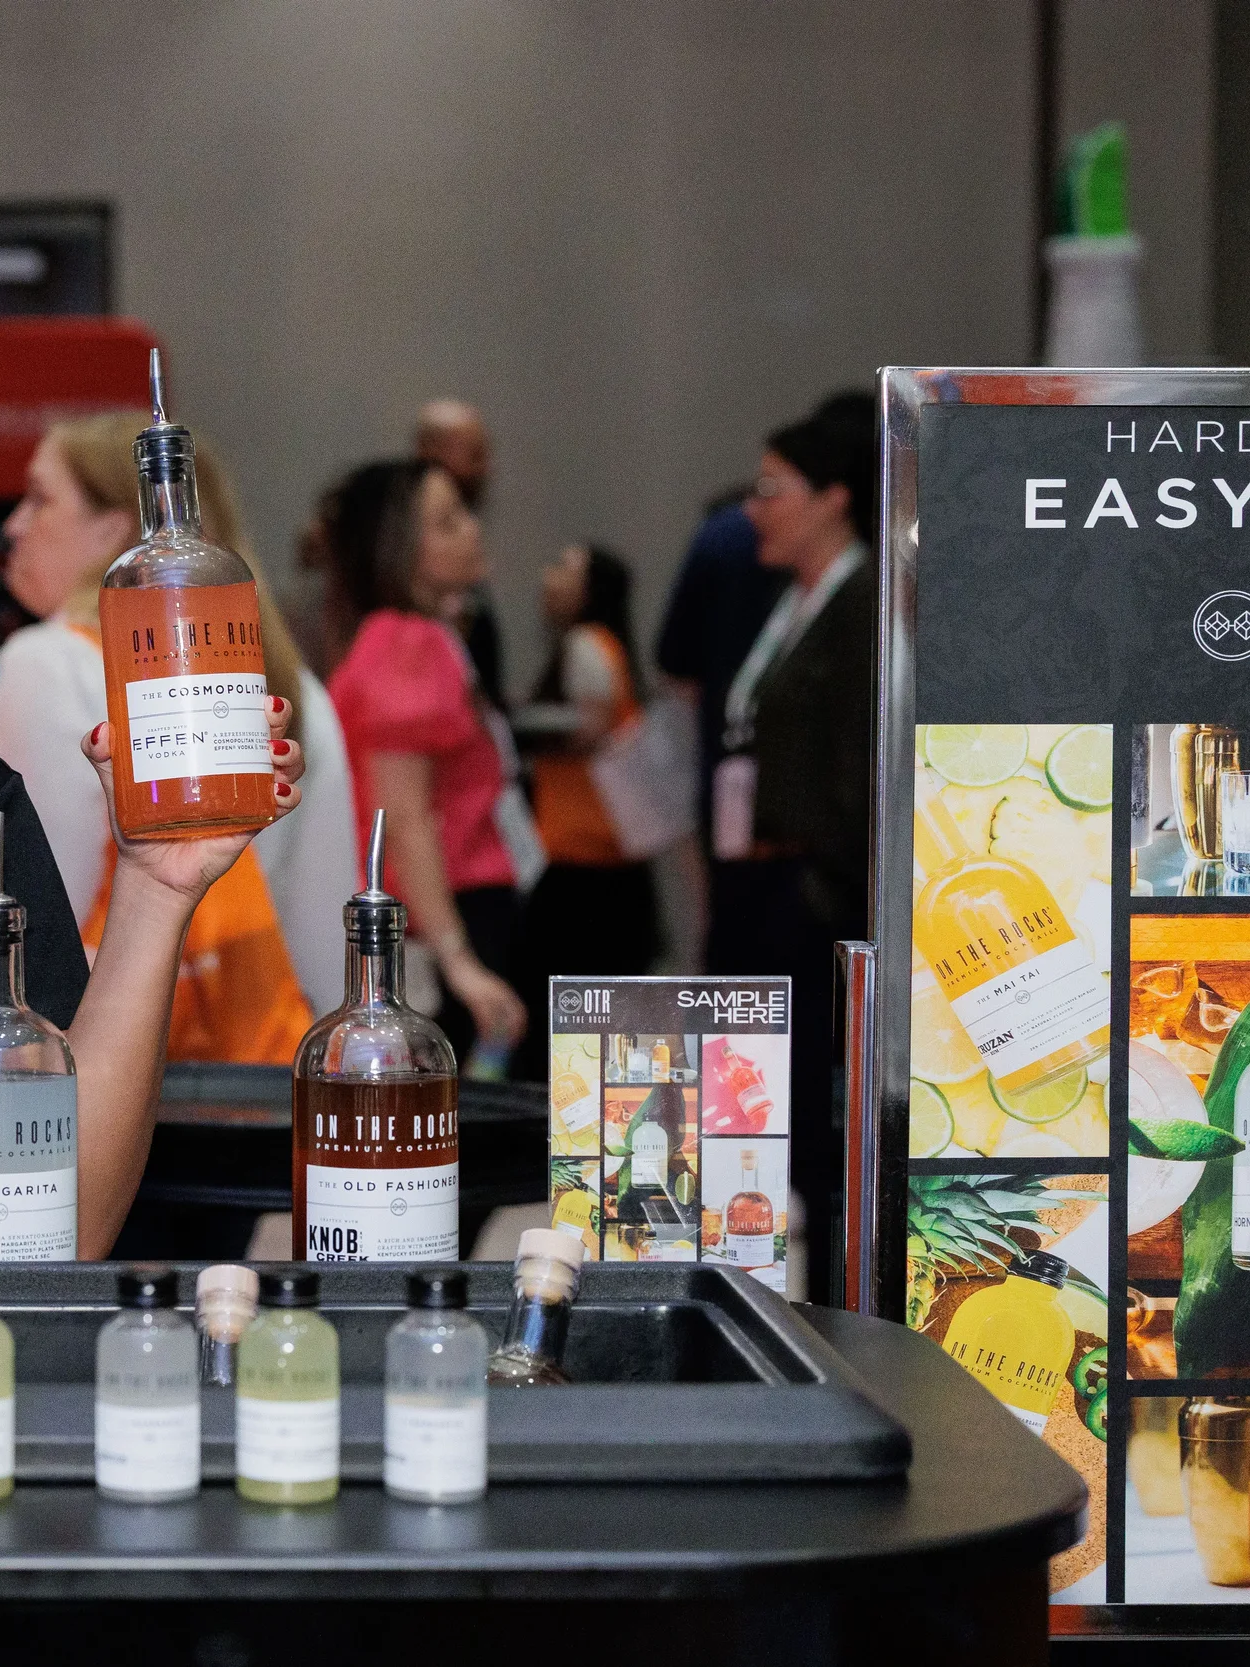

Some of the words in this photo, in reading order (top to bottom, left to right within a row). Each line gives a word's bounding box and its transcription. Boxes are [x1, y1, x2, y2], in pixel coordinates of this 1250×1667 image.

[1025, 477, 1250, 530] EASY
[132, 627, 155, 653] ON
[172, 622, 212, 648] THE
[141, 691, 163, 701] THE
[148, 750, 186, 759] VODKA
[935, 958, 954, 980] ON
[956, 937, 992, 967] THE
[998, 907, 1053, 945] ROCKS
[676, 990, 786, 1008] SAMPLE
[977, 994, 991, 1006] THE
[993, 980, 1017, 997] MAI
[1019, 968, 1041, 983] TAI
[572, 1015, 585, 1024] THE
[713, 1007, 786, 1024] HERE
[977, 1028, 1014, 1055] CRUZAN
[15, 1116, 71, 1145] ROCKS
[315, 1113, 338, 1139] ON
[355, 1115, 396, 1141] THE
[316, 1142, 383, 1153] PREMIUM
[319, 1180, 338, 1189] THE
[343, 1181, 377, 1192] OLD
[386, 1174, 457, 1192] FASHIONED
[1, 1240, 37, 1248] MARGARITA
[309, 1224, 359, 1254] KNOB
[950, 1341, 968, 1360] ON
[975, 1348, 1007, 1372] THE
[1015, 1361, 1059, 1388] ROCKS
